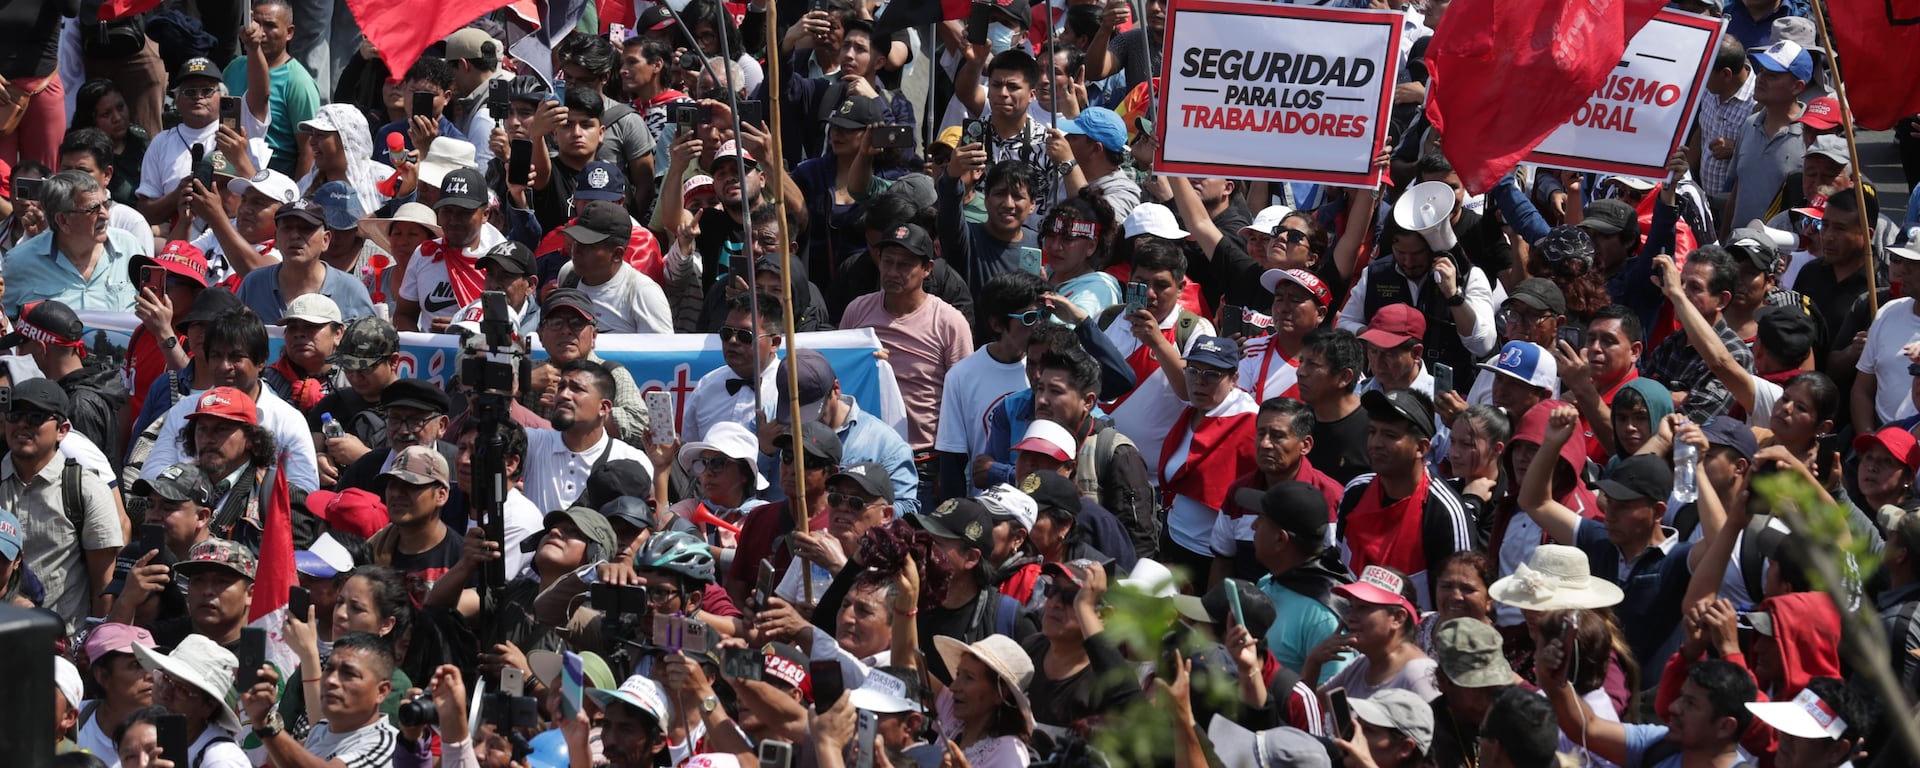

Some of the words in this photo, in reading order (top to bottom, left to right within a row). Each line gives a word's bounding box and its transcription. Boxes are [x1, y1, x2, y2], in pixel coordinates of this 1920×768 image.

[1180, 47, 1375, 88] SEGURIDAD
[1224, 85, 1278, 108] PARA
[1280, 88, 1325, 110] LOS
[1181, 104, 1368, 138] TRABAJADORES
[1570, 102, 1637, 133] ORAL
[445, 183, 468, 194] 444
